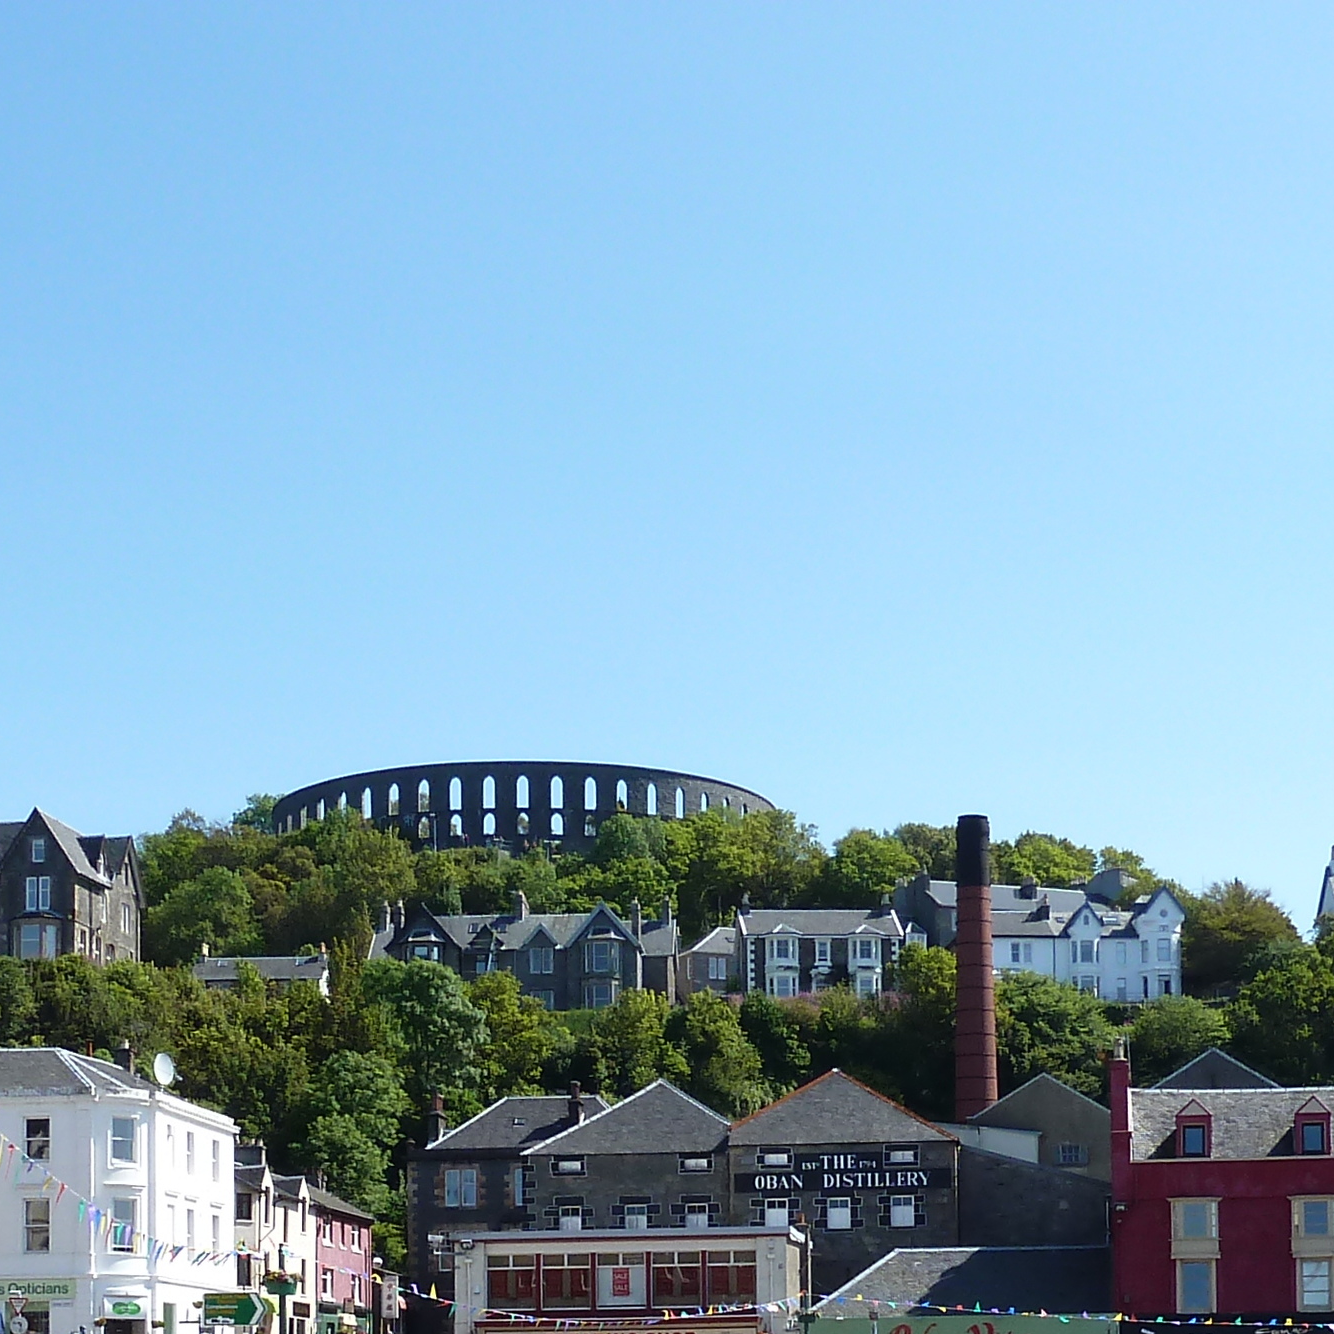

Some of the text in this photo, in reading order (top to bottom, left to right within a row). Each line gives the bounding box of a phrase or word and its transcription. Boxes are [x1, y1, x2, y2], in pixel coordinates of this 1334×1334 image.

[820, 1155, 857, 1169] THE
[754, 1171, 931, 1190] OBAN DISTILLERY
[8, 1282, 69, 1297] Opticians
